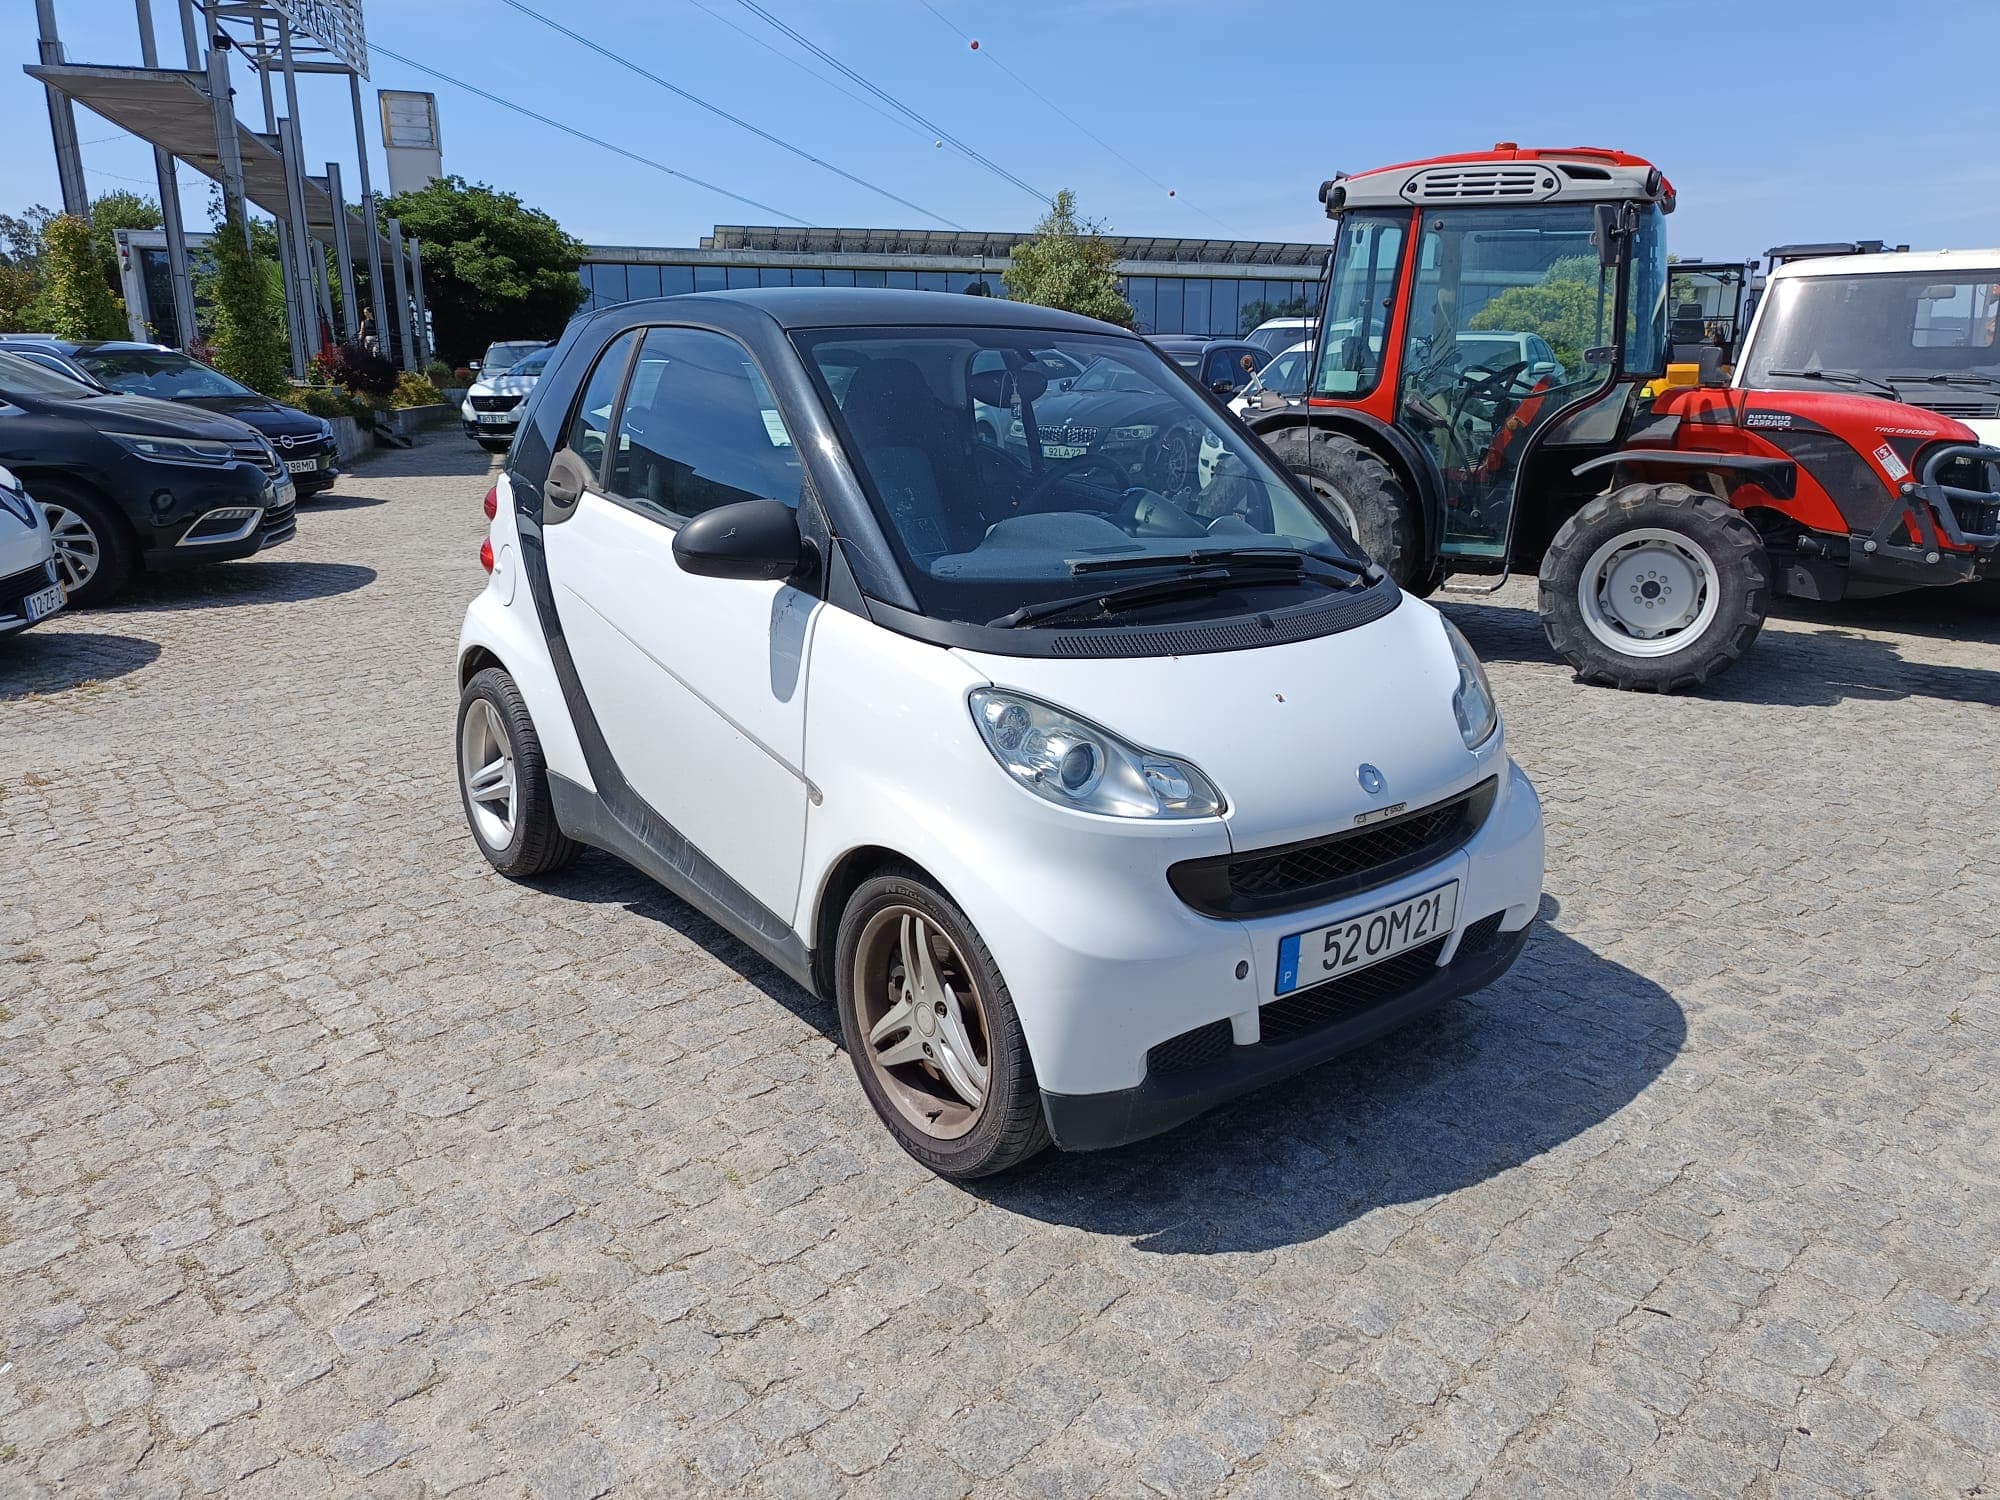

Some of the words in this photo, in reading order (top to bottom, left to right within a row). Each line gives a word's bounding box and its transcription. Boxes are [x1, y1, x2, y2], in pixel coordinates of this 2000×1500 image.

[1747, 419, 1791, 427] CARRARO
[1284, 971, 1291, 984] P
[1322, 894, 1441, 971] 52OM21
